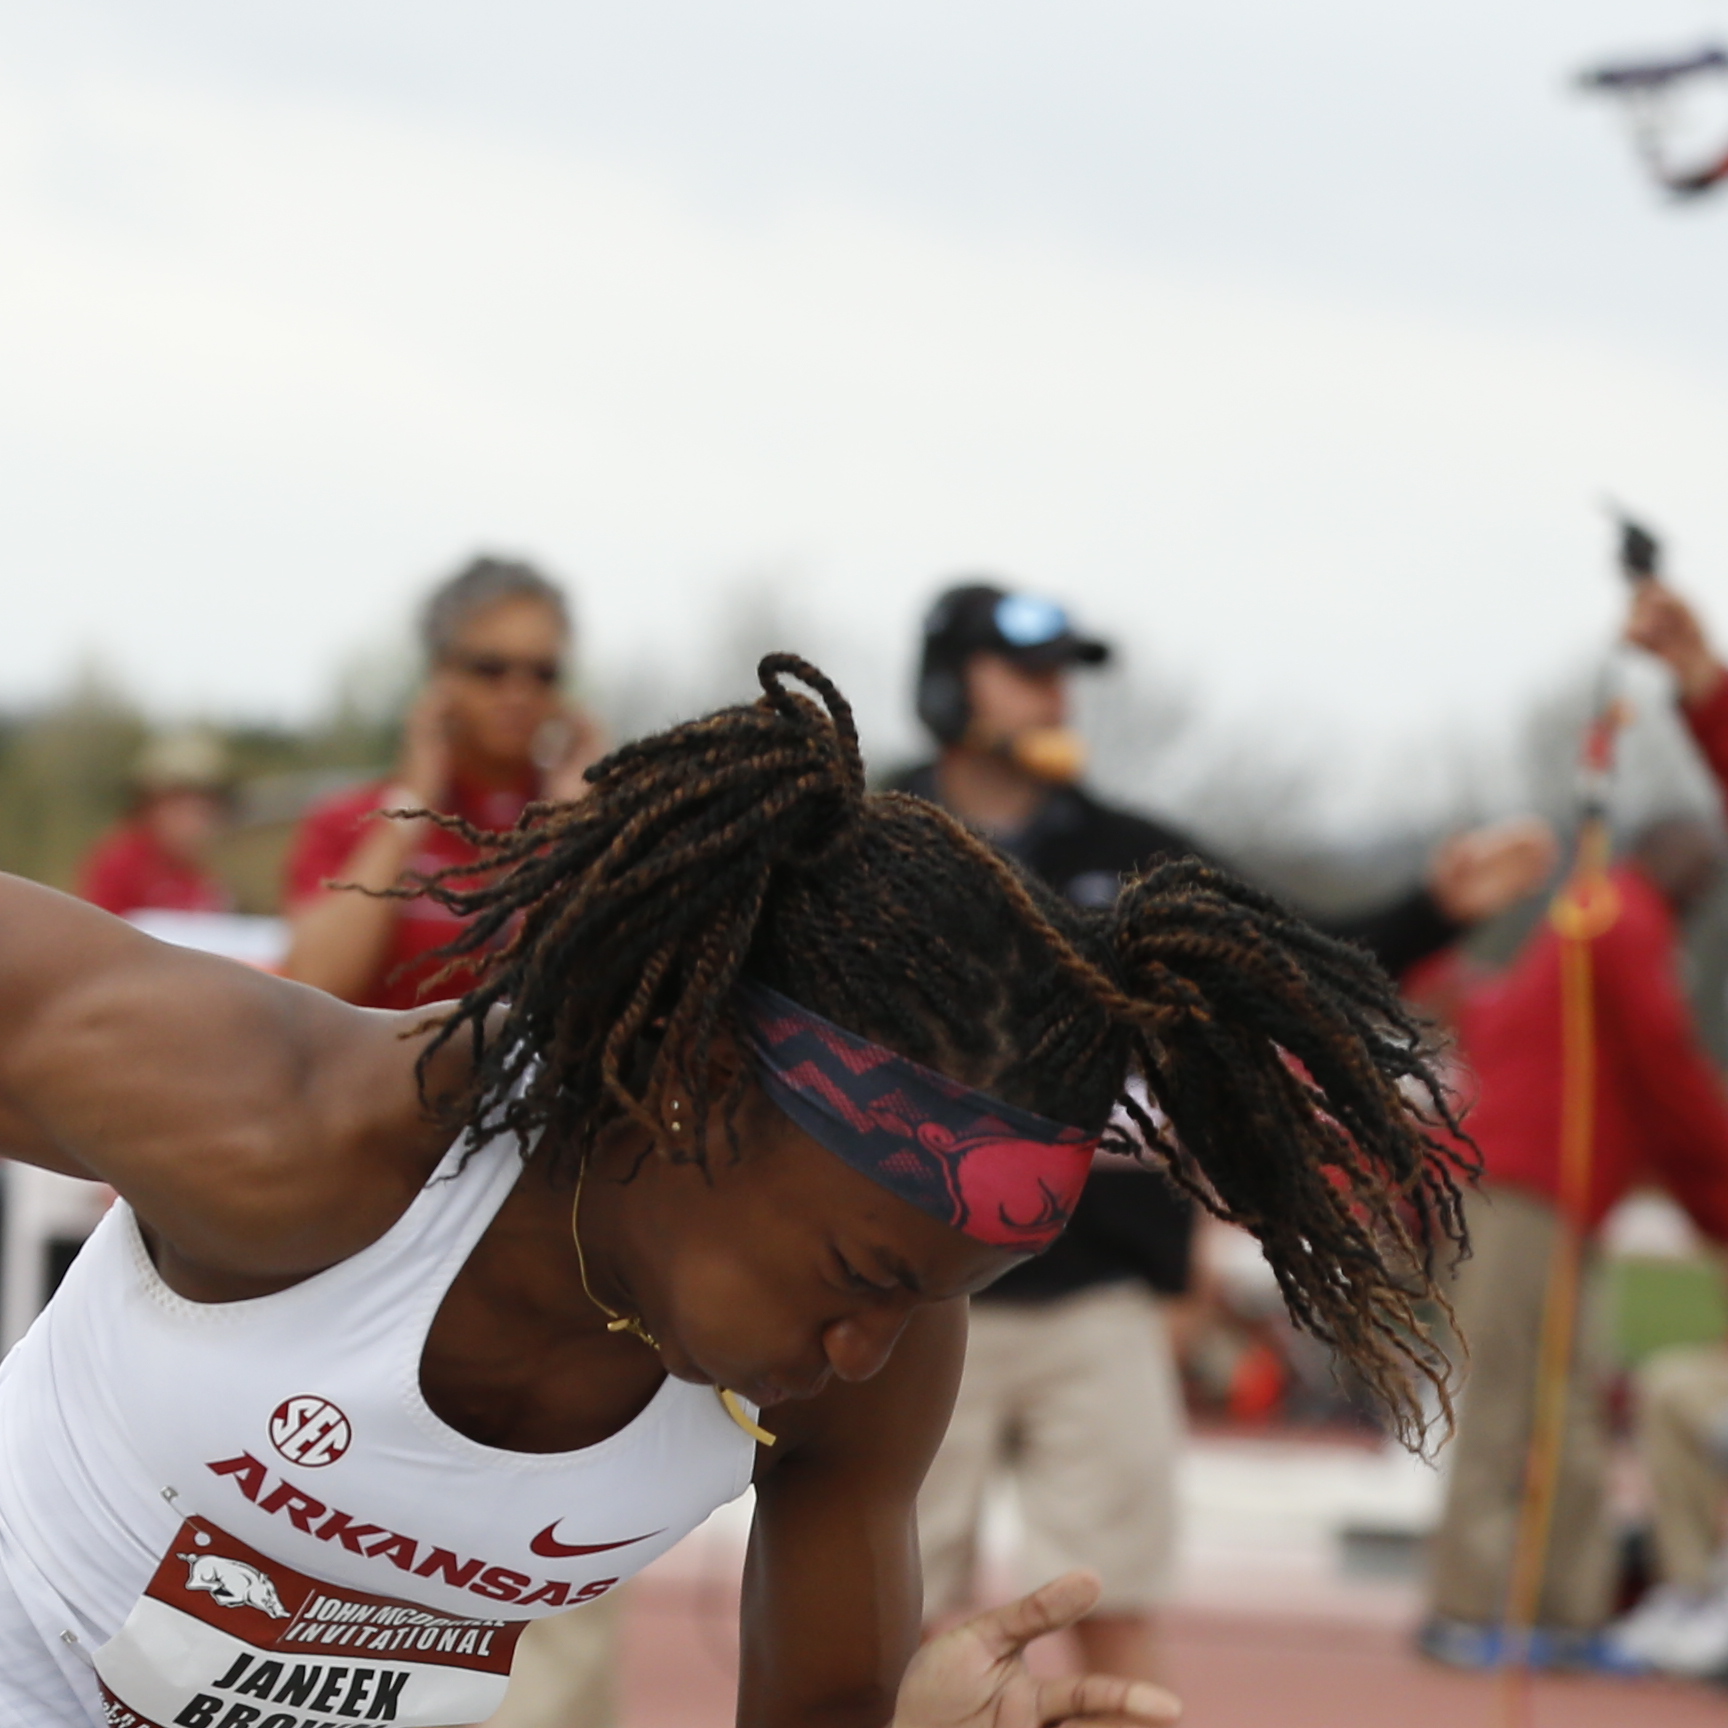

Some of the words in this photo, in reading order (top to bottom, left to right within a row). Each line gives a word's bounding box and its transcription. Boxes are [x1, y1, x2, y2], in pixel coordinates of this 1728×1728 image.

[271, 1396, 350, 1467] SEC
[204, 1449, 620, 1607] ARKANSAS
[284, 1622, 495, 1657] INVITATIONAL
[304, 1595, 375, 1623] JOHN
[370, 1605, 507, 1628] MCDOLL
[211, 1652, 411, 1721] JANEEK
